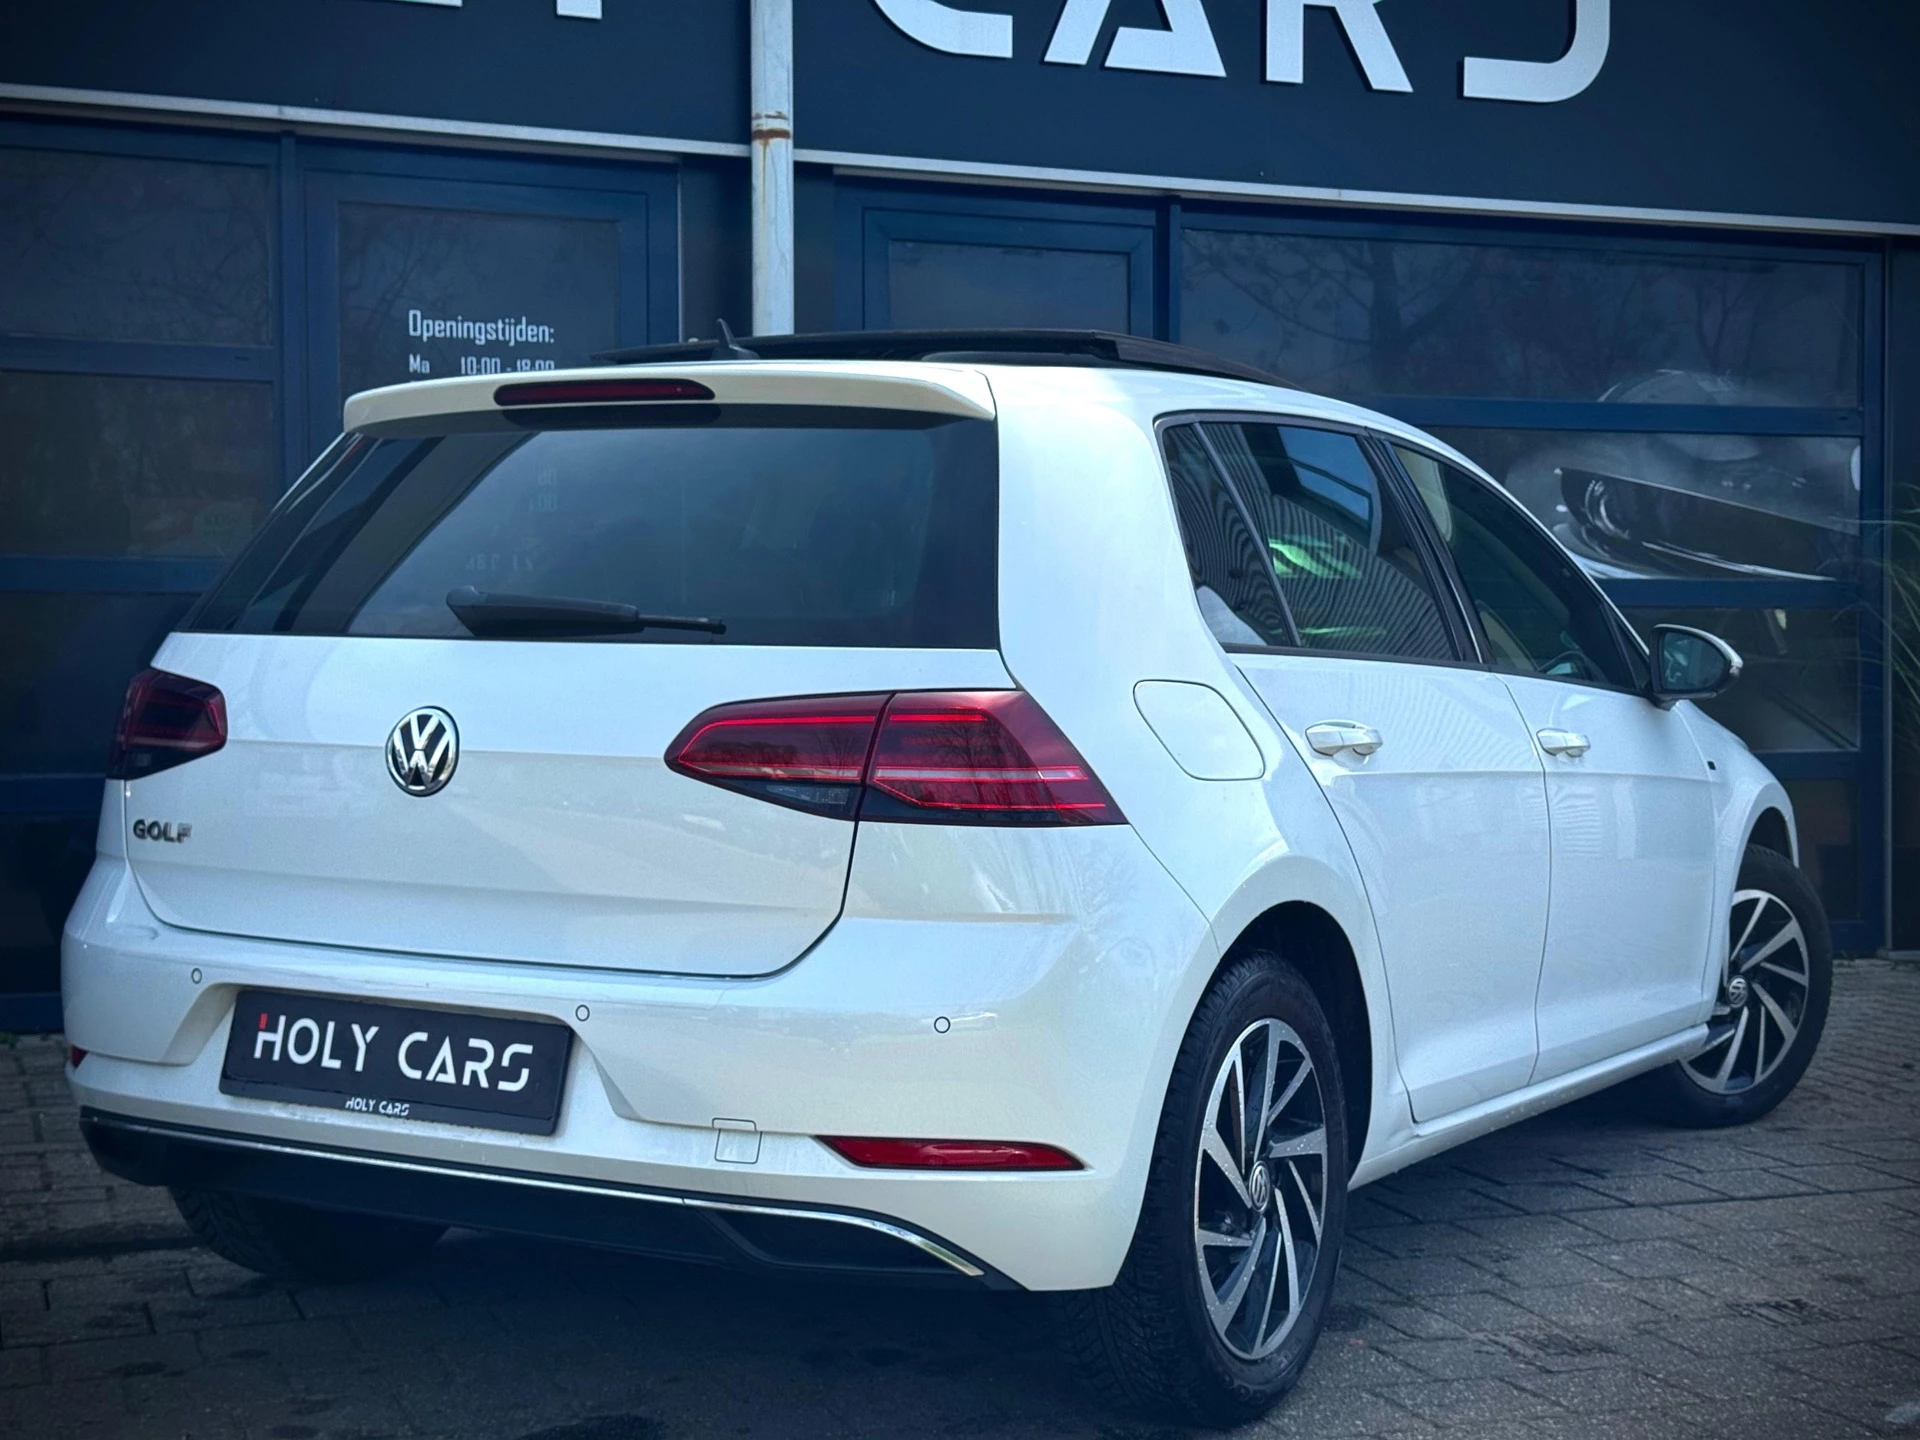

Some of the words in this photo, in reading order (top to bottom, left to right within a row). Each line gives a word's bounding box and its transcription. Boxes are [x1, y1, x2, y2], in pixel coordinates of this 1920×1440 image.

[408, 309, 555, 346] Openingstijden:
[409, 353, 430, 374] Ma
[461, 356, 500, 374] 10:00
[133, 818, 192, 843] GOLF
[253, 1012, 380, 1072] HOLY
[398, 1031, 534, 1092] CARS
[344, 1096, 376, 1112] HOLY
[378, 1100, 410, 1116] CARS
